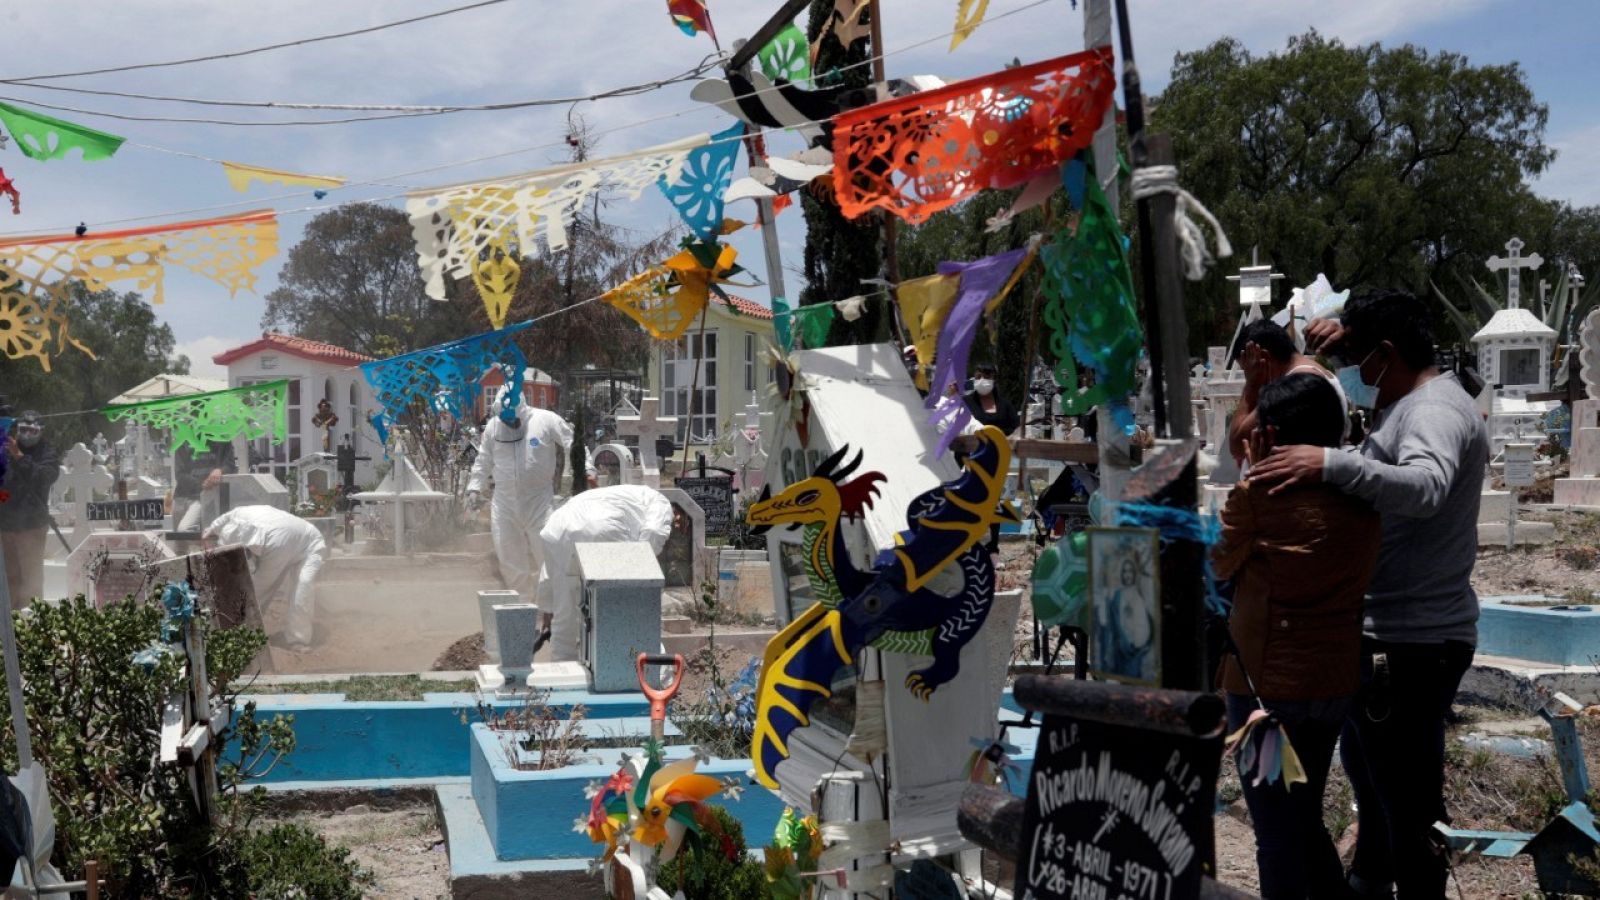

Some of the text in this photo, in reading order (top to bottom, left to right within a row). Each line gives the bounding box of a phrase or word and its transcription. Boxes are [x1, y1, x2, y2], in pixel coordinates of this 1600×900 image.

[1036, 751, 1195, 877] Ricardo Moreno Soriano
